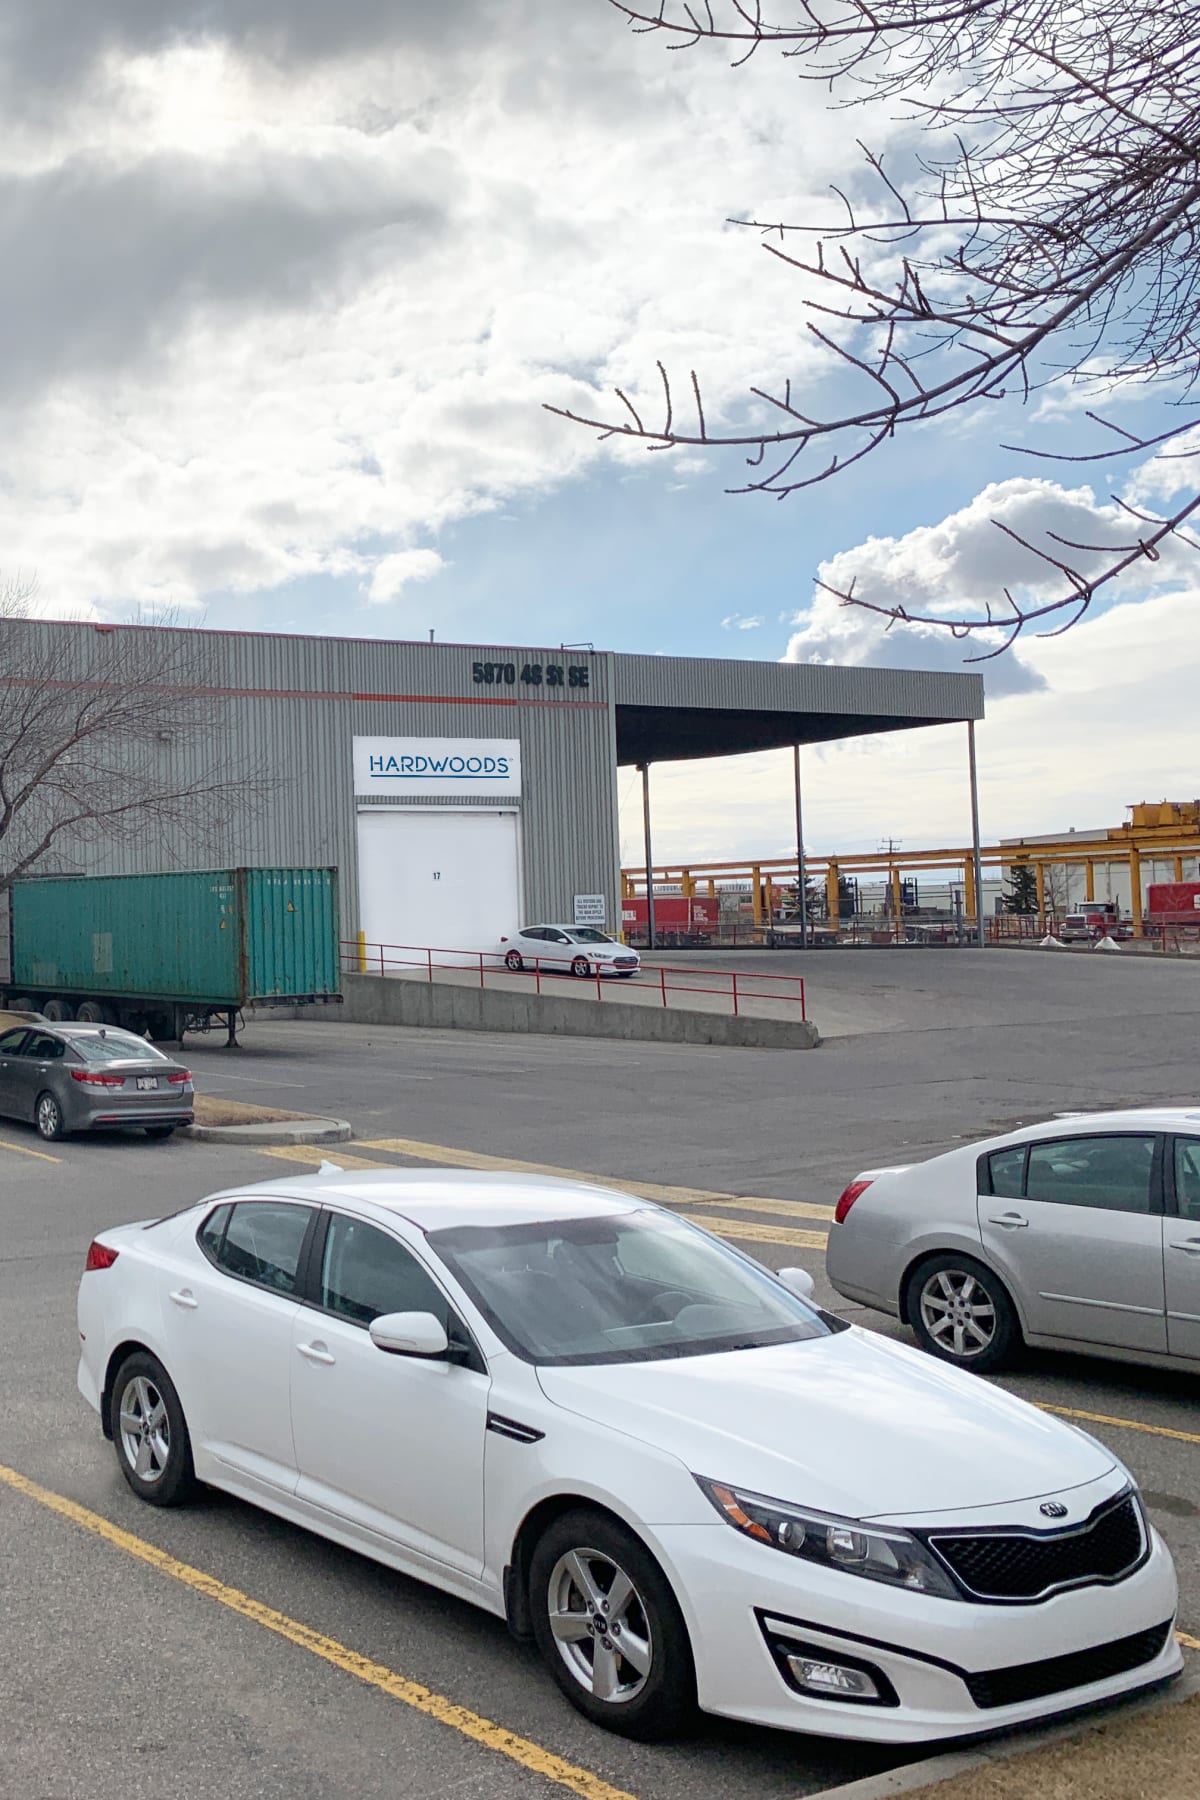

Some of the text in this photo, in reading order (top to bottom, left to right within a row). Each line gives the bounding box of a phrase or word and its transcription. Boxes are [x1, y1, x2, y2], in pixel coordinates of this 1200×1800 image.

[472, 662, 515, 685] 5870
[546, 665, 564, 686] St
[568, 665, 589, 688] SE
[370, 755, 509, 773] HARDWOODS
[433, 871, 441, 880] 17
